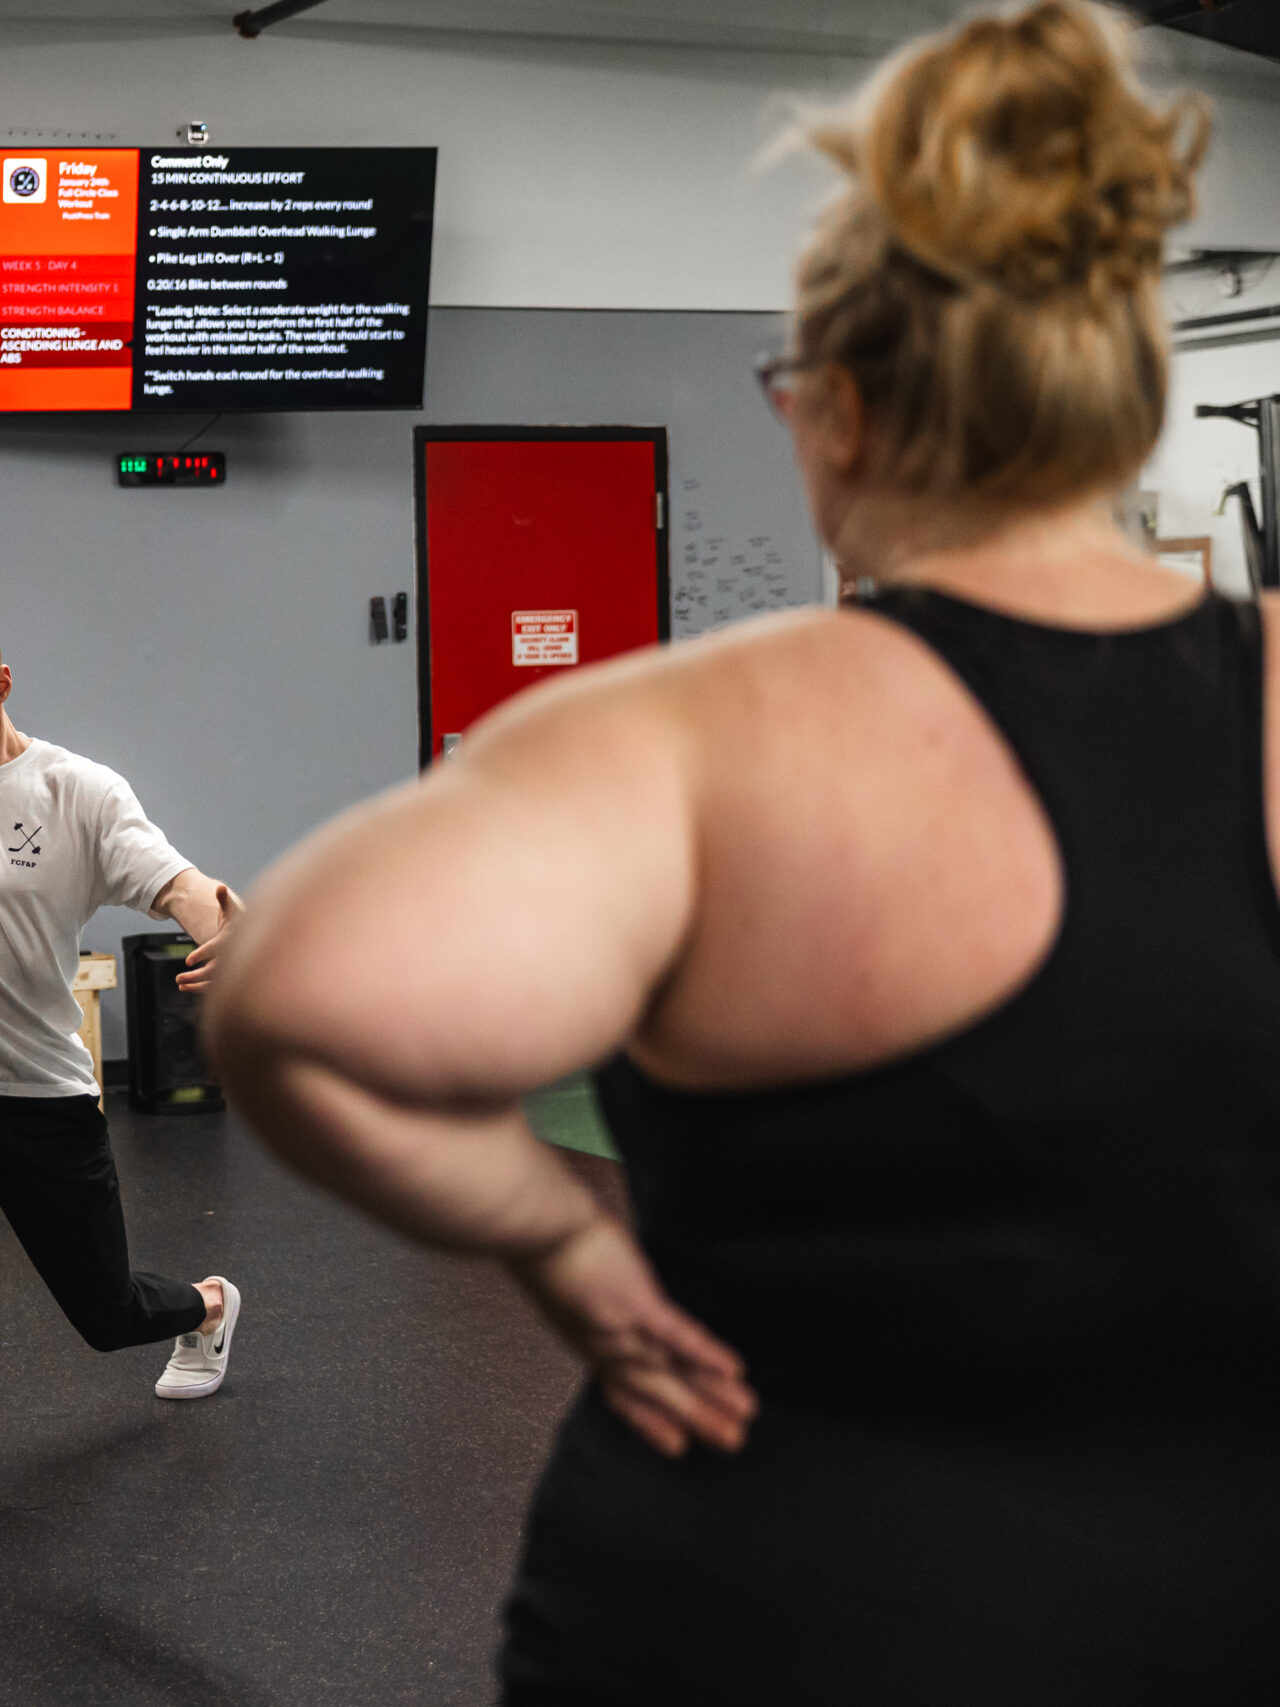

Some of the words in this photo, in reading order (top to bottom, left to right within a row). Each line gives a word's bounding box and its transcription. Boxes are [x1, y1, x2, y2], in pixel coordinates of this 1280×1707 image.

[59, 162, 97, 176] Friday
[151, 155, 202, 168] Comment
[202, 155, 229, 170] Only
[152, 172, 165, 184] 15
[166, 172, 188, 184] MIN
[189, 172, 261, 184] CONTINUOUS
[262, 172, 305, 184] EFFORT
[58, 189, 73, 198] Full
[73, 189, 96, 198] Circle
[96, 189, 119, 198] Class
[230, 199, 270, 210] increase
[271, 199, 284, 212] by
[284, 199, 292, 210] 2
[292, 200, 314, 212] reps
[314, 200, 342, 212] every
[342, 198, 373, 210] round
[157, 226, 188, 239] Single
[188, 226, 210, 238] Arm
[210, 226, 258, 238] Dumbbell
[258, 225, 306, 237] Overhead
[306, 225, 346, 238] Walking
[346, 225, 377, 238] Lunge
[2, 261, 32, 270] WEEK
[35, 261, 40, 270] 5
[48, 261, 69, 270] DAY
[70, 261, 77, 270] 4
[157, 252, 178, 264] Pike
[179, 252, 197, 266] Leg
[198, 252, 215, 264] Lift
[215, 252, 240, 264] Over
[2, 283, 57, 293] STRENGTH
[58, 283, 110, 293] INTENSITY
[188, 279, 210, 290] Bike
[210, 279, 252, 290] between
[253, 278, 288, 290] rounds
[2, 306, 56, 316] STRENGTH
[58, 306, 104, 316] BALANCE
[194, 305, 222, 316] Note:
[222, 304, 252, 316] Select
[260, 304, 306, 316] moderate
[306, 304, 340, 317] weight
[340, 303, 354, 315] for
[356, 303, 372, 315] the
[372, 303, 410, 316] walking
[146, 318, 173, 332] lunge
[174, 318, 194, 330] that
[195, 318, 226, 330] allows
[226, 319, 246, 331] you
[246, 318, 257, 329] to
[258, 317, 297, 330] perform
[298, 317, 314, 328] the
[314, 316, 334, 328] first
[336, 316, 354, 328] half
[354, 316, 365, 328] of
[366, 316, 384, 328] the
[145, 331, 186, 343] workout
[187, 331, 210, 342] with
[210, 330, 248, 342] minimal
[248, 330, 284, 342] breaks.
[284, 330, 302, 341] The
[304, 329, 336, 342] weight
[337, 329, 368, 340] should
[369, 329, 392, 340] start
[393, 329, 405, 340] to
[0, 339, 62, 351] ASCENDING
[62, 339, 98, 350] LUNGE
[98, 339, 123, 350] AND
[145, 344, 164, 356] feel
[165, 344, 200, 356] heavier
[202, 344, 212, 355] in
[212, 344, 229, 355] the
[230, 343, 256, 355] latter
[257, 343, 276, 355] half
[276, 343, 288, 354] of
[288, 343, 304, 354] the
[305, 343, 348, 354] workout.
[0, 352, 22, 364] ABS
[186, 369, 216, 381] hands
[216, 369, 239, 380] each
[240, 369, 269, 380] round
[270, 369, 284, 380] for
[284, 368, 301, 380] the
[302, 368, 346, 380] overhead
[347, 368, 384, 381] walking
[144, 383, 174, 396] lunge.
[10, 858, 36, 868] FCF&P
